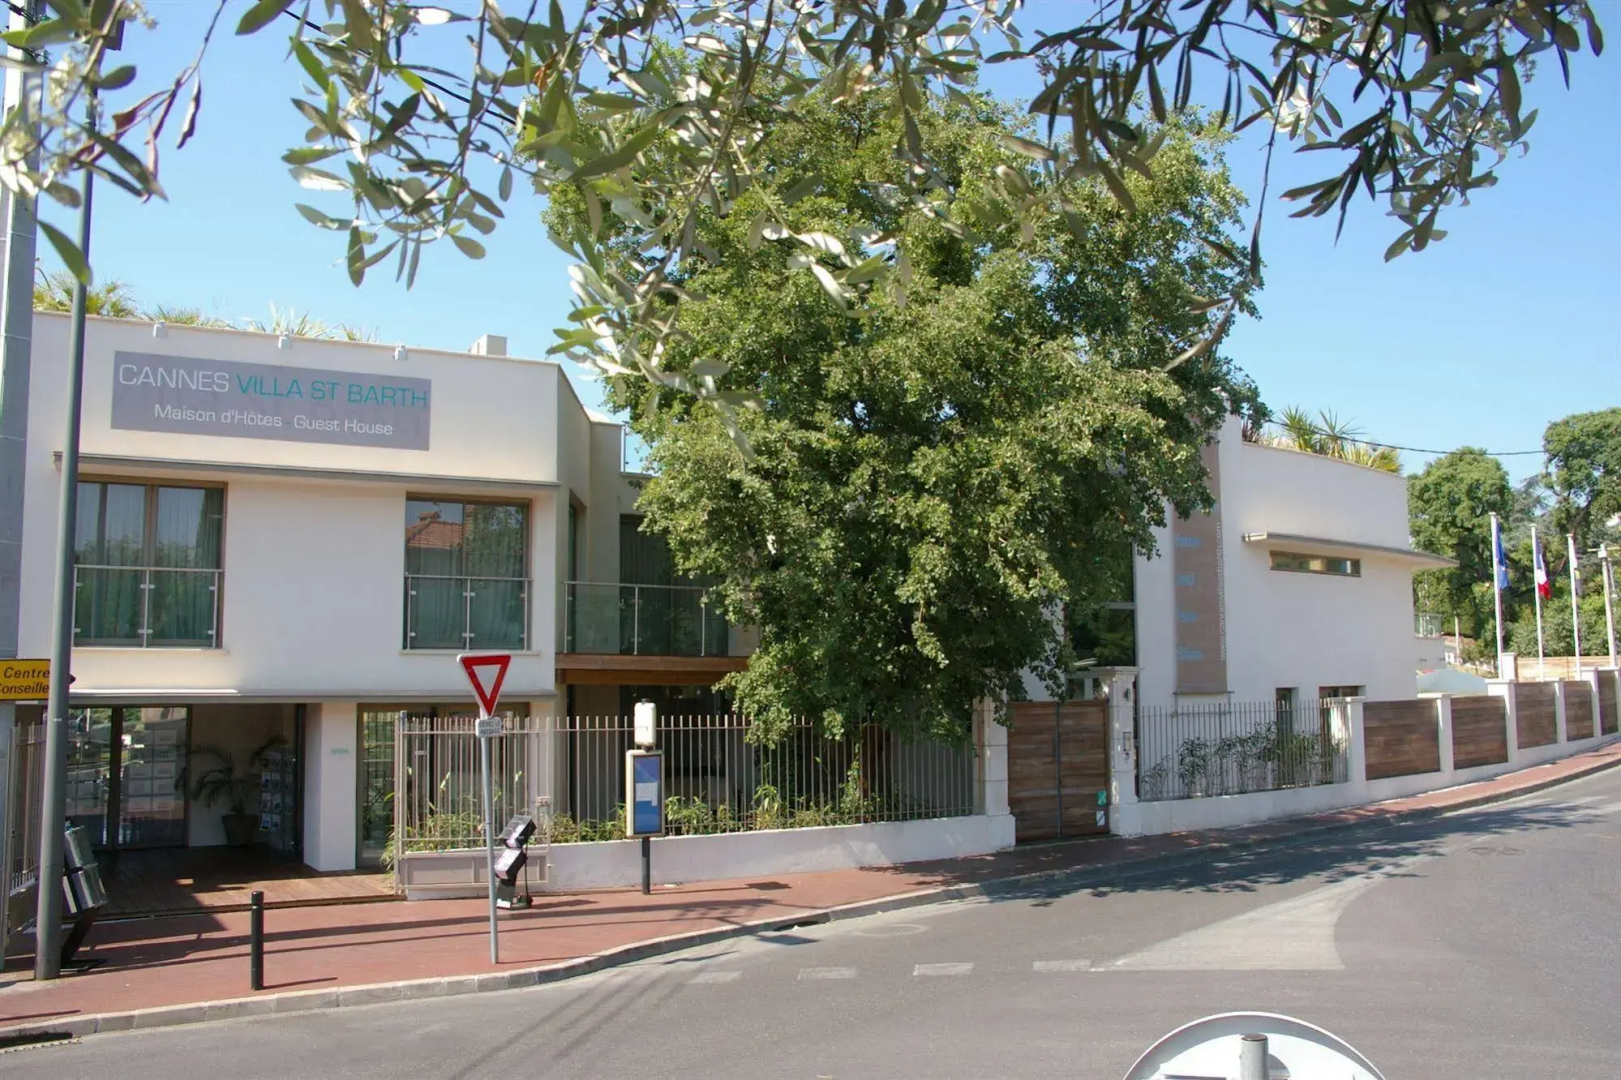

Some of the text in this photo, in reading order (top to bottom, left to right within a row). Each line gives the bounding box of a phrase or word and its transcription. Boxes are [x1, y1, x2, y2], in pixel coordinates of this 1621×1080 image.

[119, 363, 428, 408] CANNES VILLA ST BARTH
[154, 403, 216, 422] Maison
[221, 409, 283, 428] d'Hôtes
[294, 414, 341, 431] Guest
[344, 418, 393, 435] House
[3, 666, 50, 679] Centre
